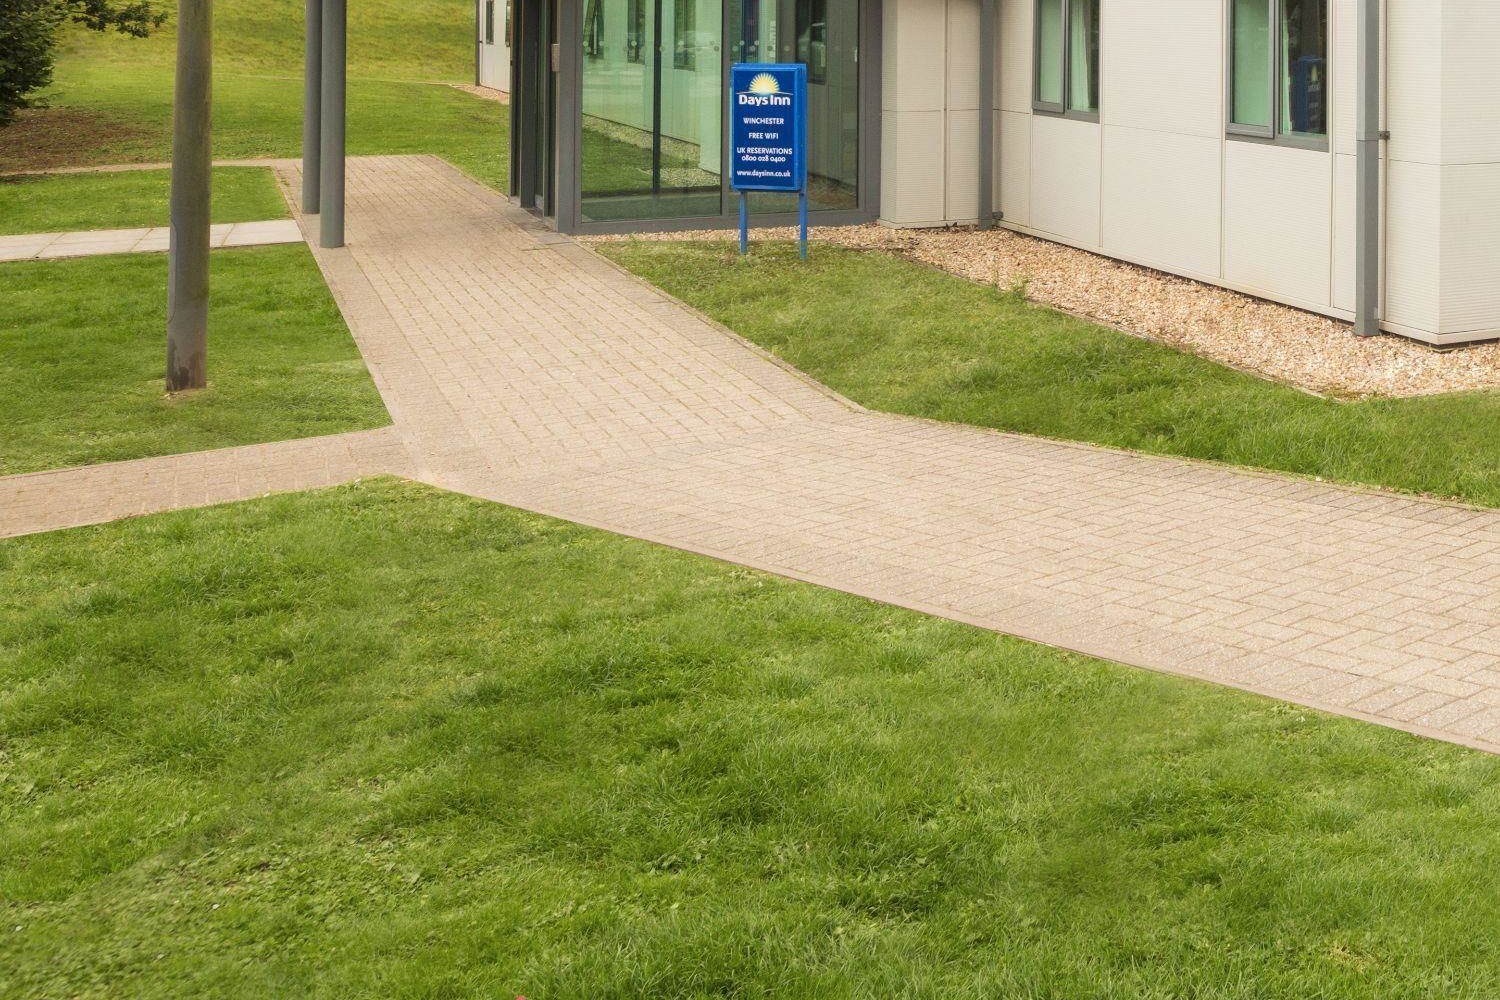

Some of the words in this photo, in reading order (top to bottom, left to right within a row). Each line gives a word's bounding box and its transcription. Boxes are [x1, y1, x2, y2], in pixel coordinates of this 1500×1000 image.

[739, 94, 768, 107] Days
[770, 95, 790, 106] Inn
[743, 117, 784, 125] WINCHESTER
[747, 147, 792, 155] RESERVATIONS
[737, 170, 790, 178] www.daysinn.co.uk
